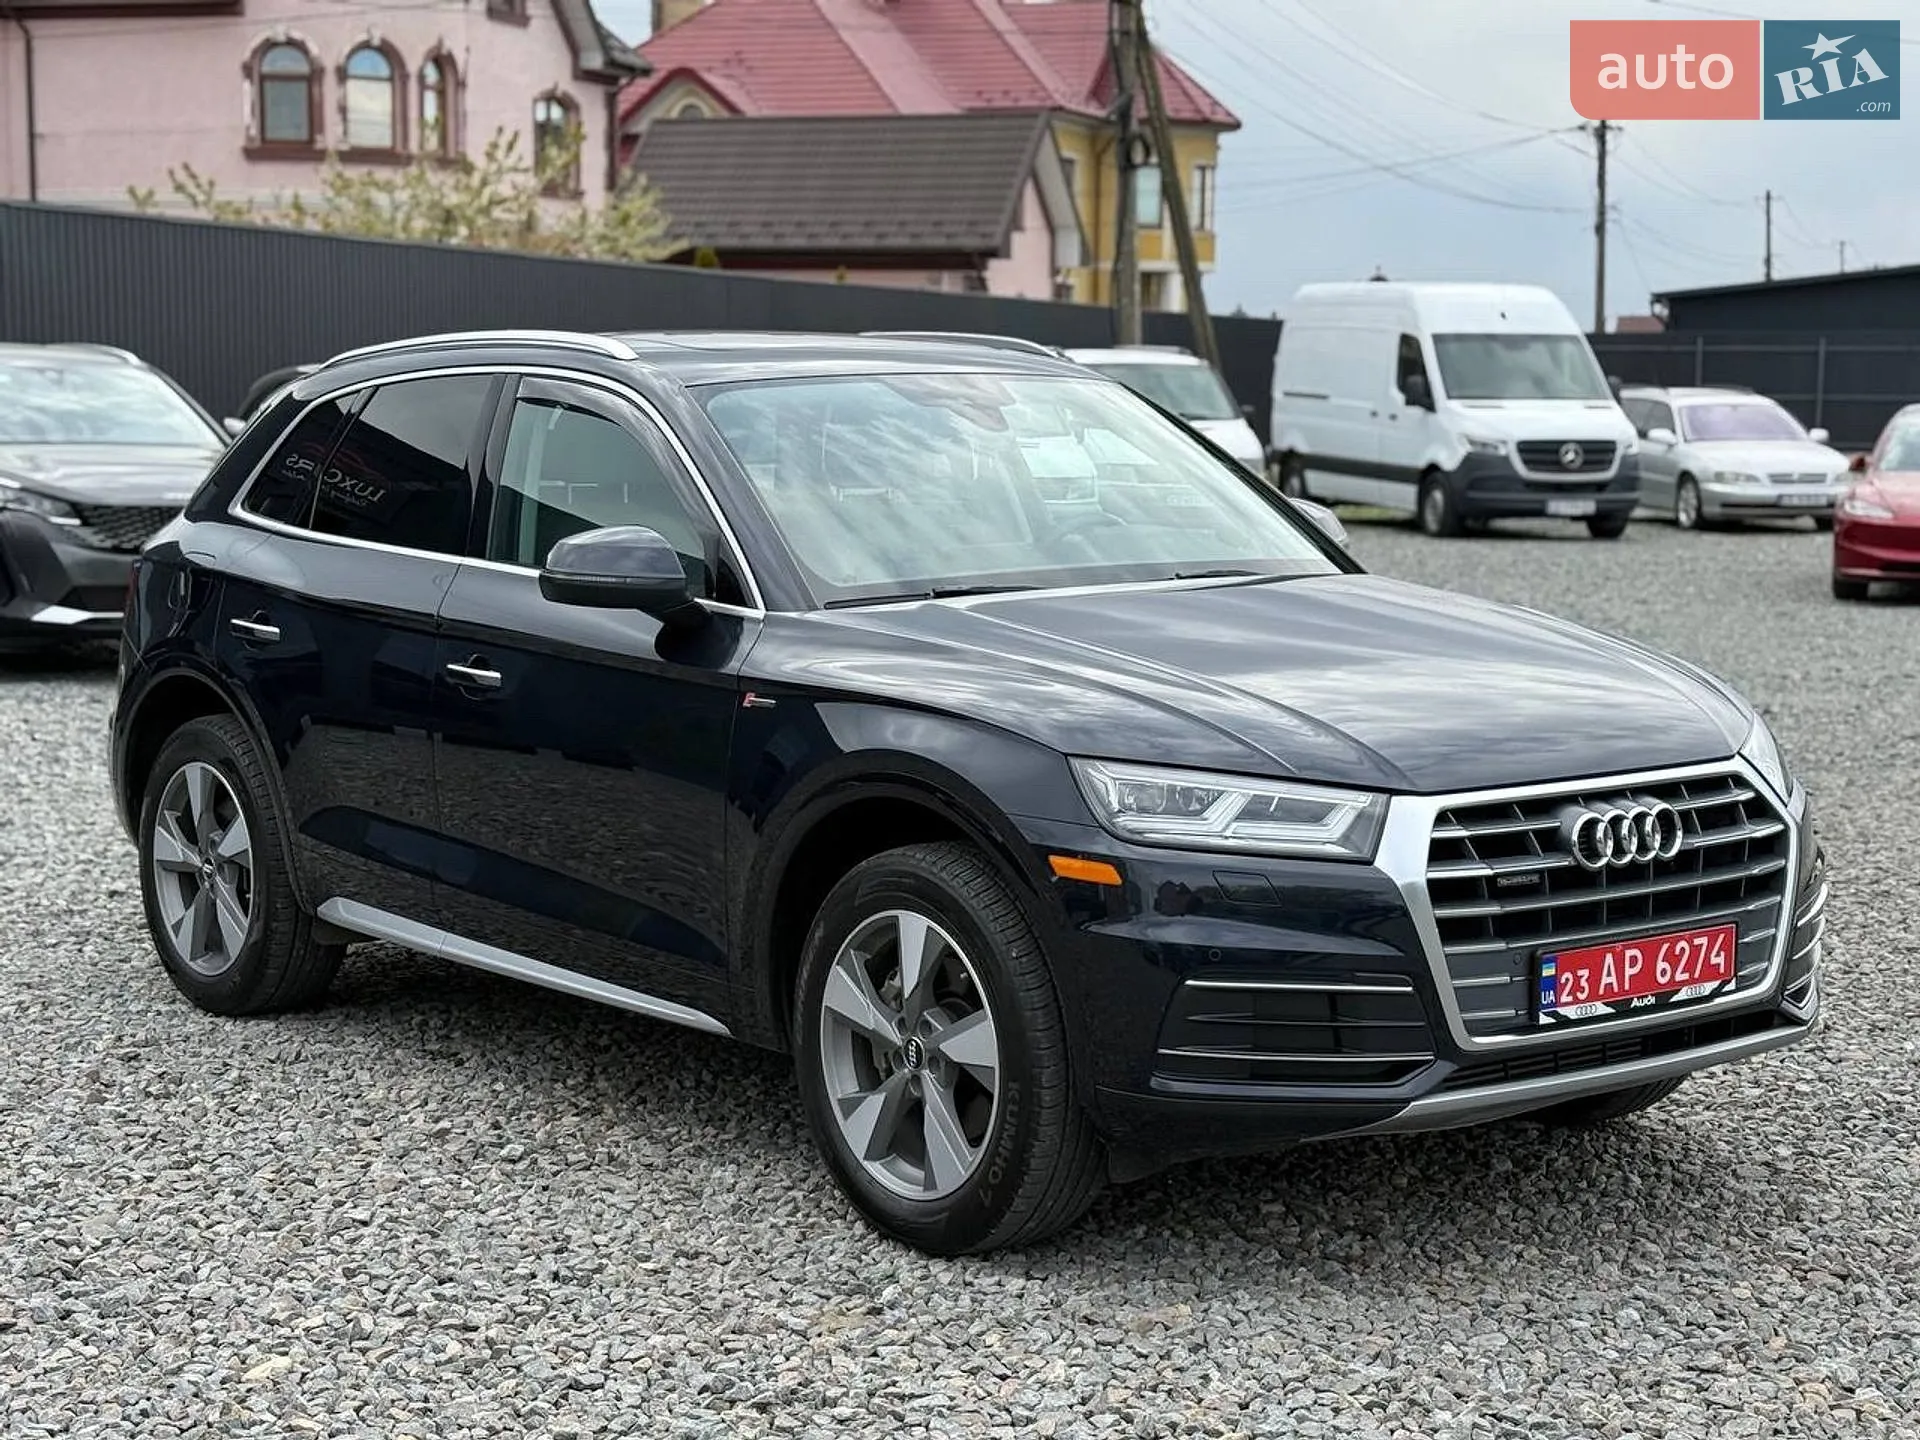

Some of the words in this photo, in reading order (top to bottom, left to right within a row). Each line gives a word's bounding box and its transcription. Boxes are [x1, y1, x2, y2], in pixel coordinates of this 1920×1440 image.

[1541, 990, 1556, 1005] UA
[1560, 968, 1590, 1004] 23
[1598, 948, 1644, 996] AP
[1655, 932, 1726, 985] 6274
[988, 1081, 1021, 1185] KUMHO
